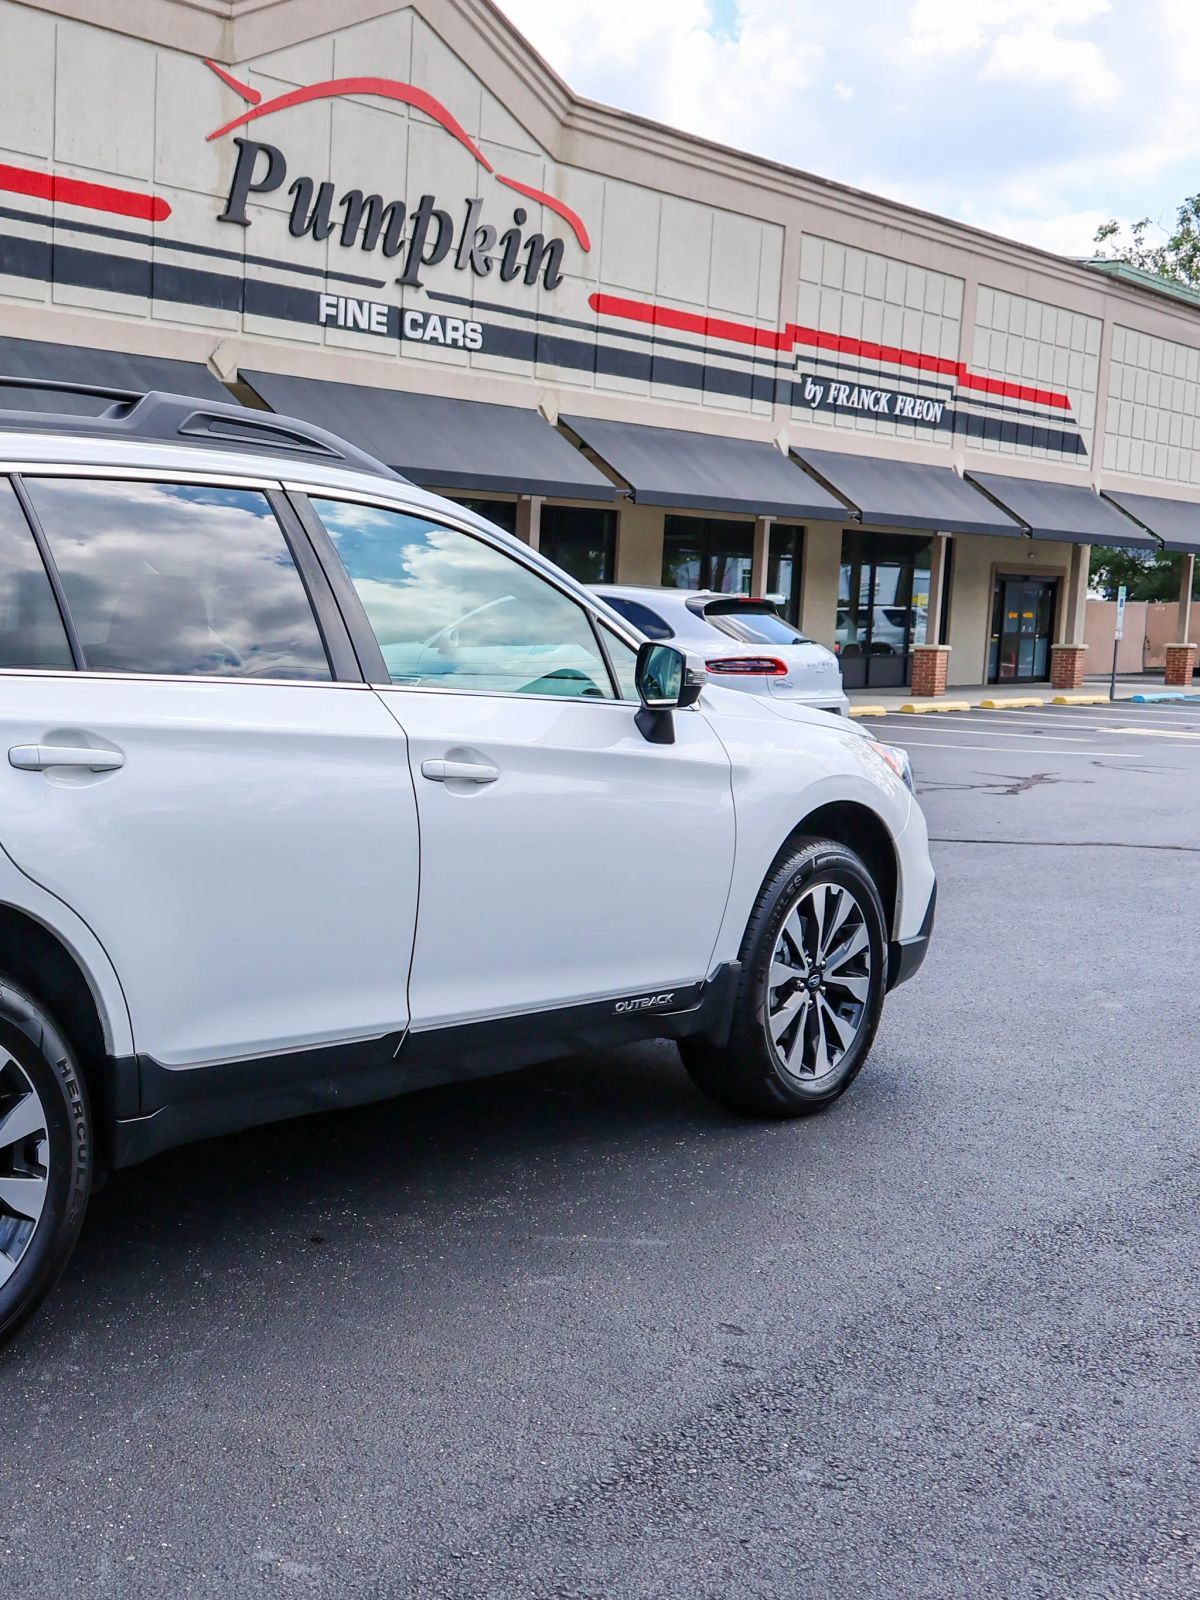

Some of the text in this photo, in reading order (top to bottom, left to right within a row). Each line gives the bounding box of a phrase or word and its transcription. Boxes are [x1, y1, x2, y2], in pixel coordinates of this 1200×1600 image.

[217, 137, 565, 290] Pumpkin
[319, 294, 483, 350] FINE CARS
[804, 377, 944, 423] by FRANCK FREON
[615, 993, 675, 1012] OUTBACK
